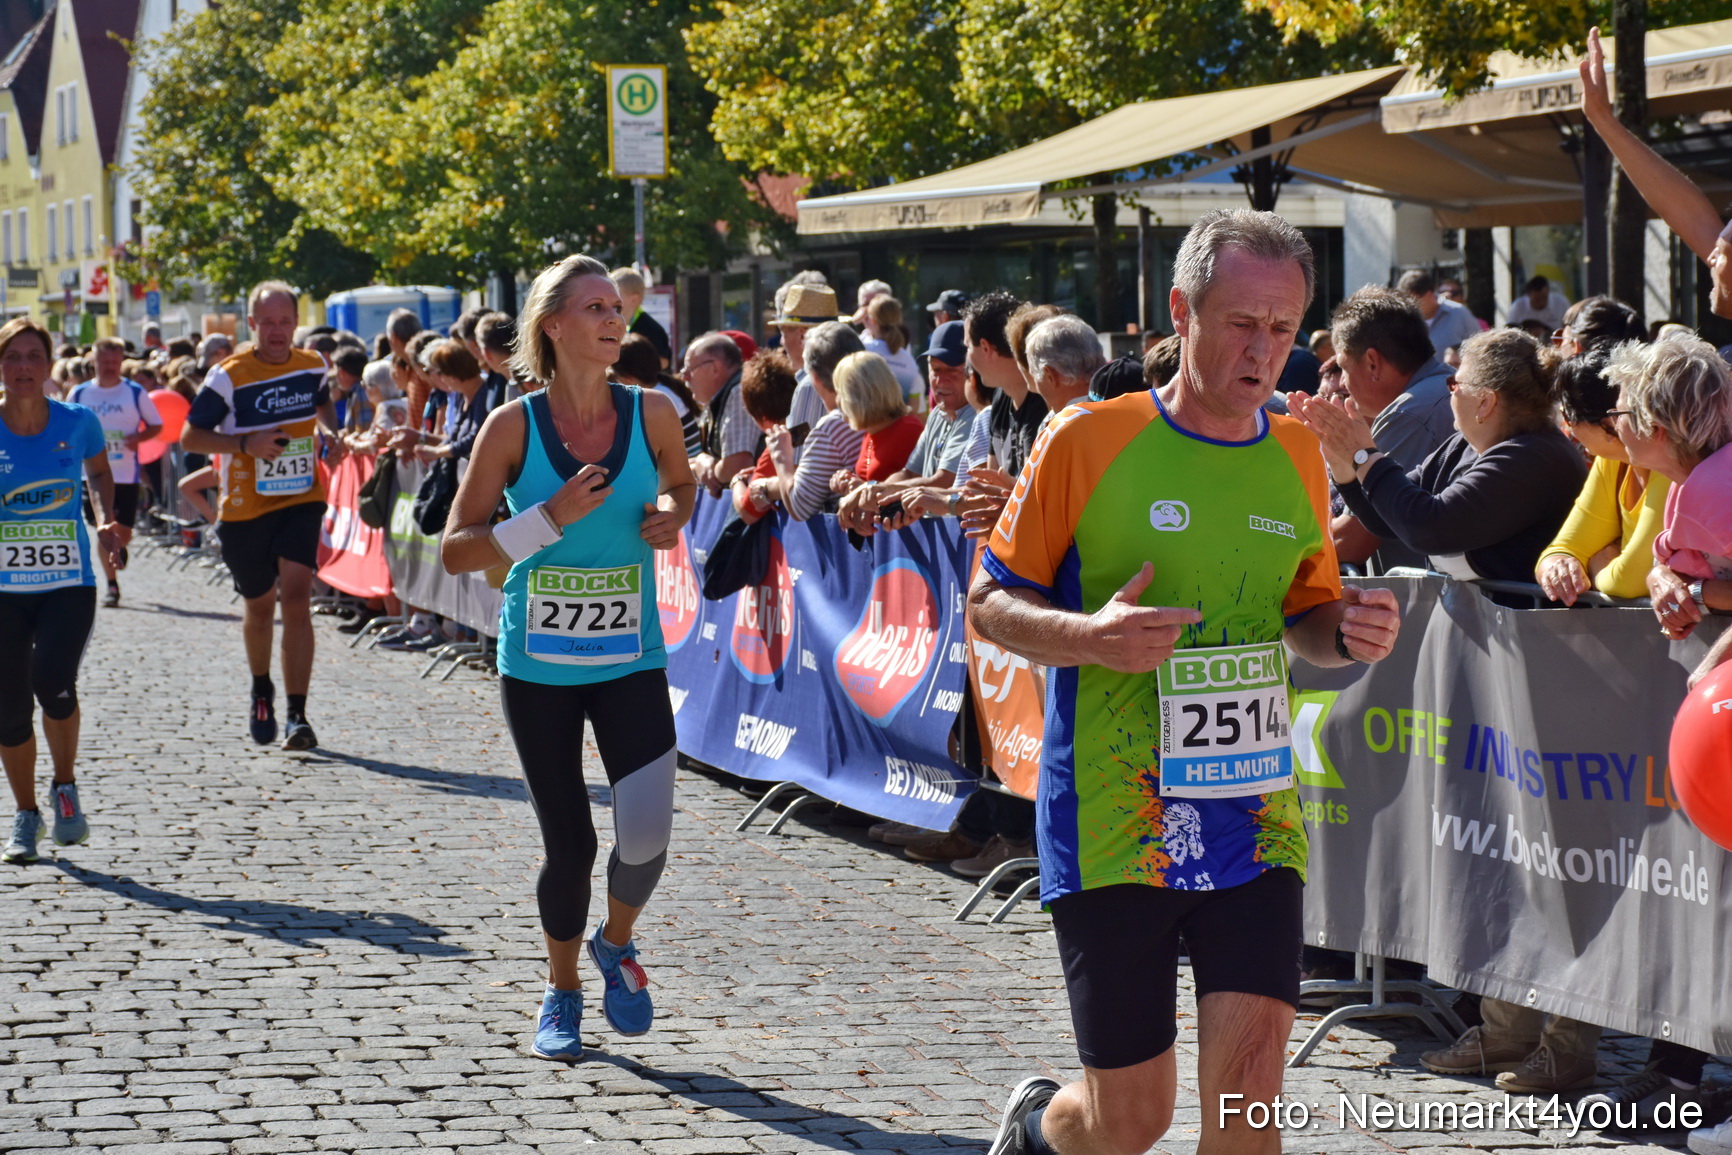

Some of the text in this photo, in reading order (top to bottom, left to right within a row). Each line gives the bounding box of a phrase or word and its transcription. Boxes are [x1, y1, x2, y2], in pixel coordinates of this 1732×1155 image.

[628, 83, 647, 106] H
[267, 392, 313, 409] Fischer
[264, 457, 309, 477] 2413
[4, 524, 68, 539] BOCK
[1249, 515, 1296, 539] BOCK
[6, 545, 70, 567] 2363
[10, 570, 68, 583] BRIGITTE
[538, 570, 630, 593] BOCK
[541, 600, 627, 631] 2722
[560, 640, 604, 653] Julia
[842, 600, 933, 688] Hervis
[1172, 651, 1278, 688] BOCK
[1182, 697, 1279, 747] 2514
[885, 756, 909, 797] GET
[1186, 755, 1279, 781] HELMUTH
